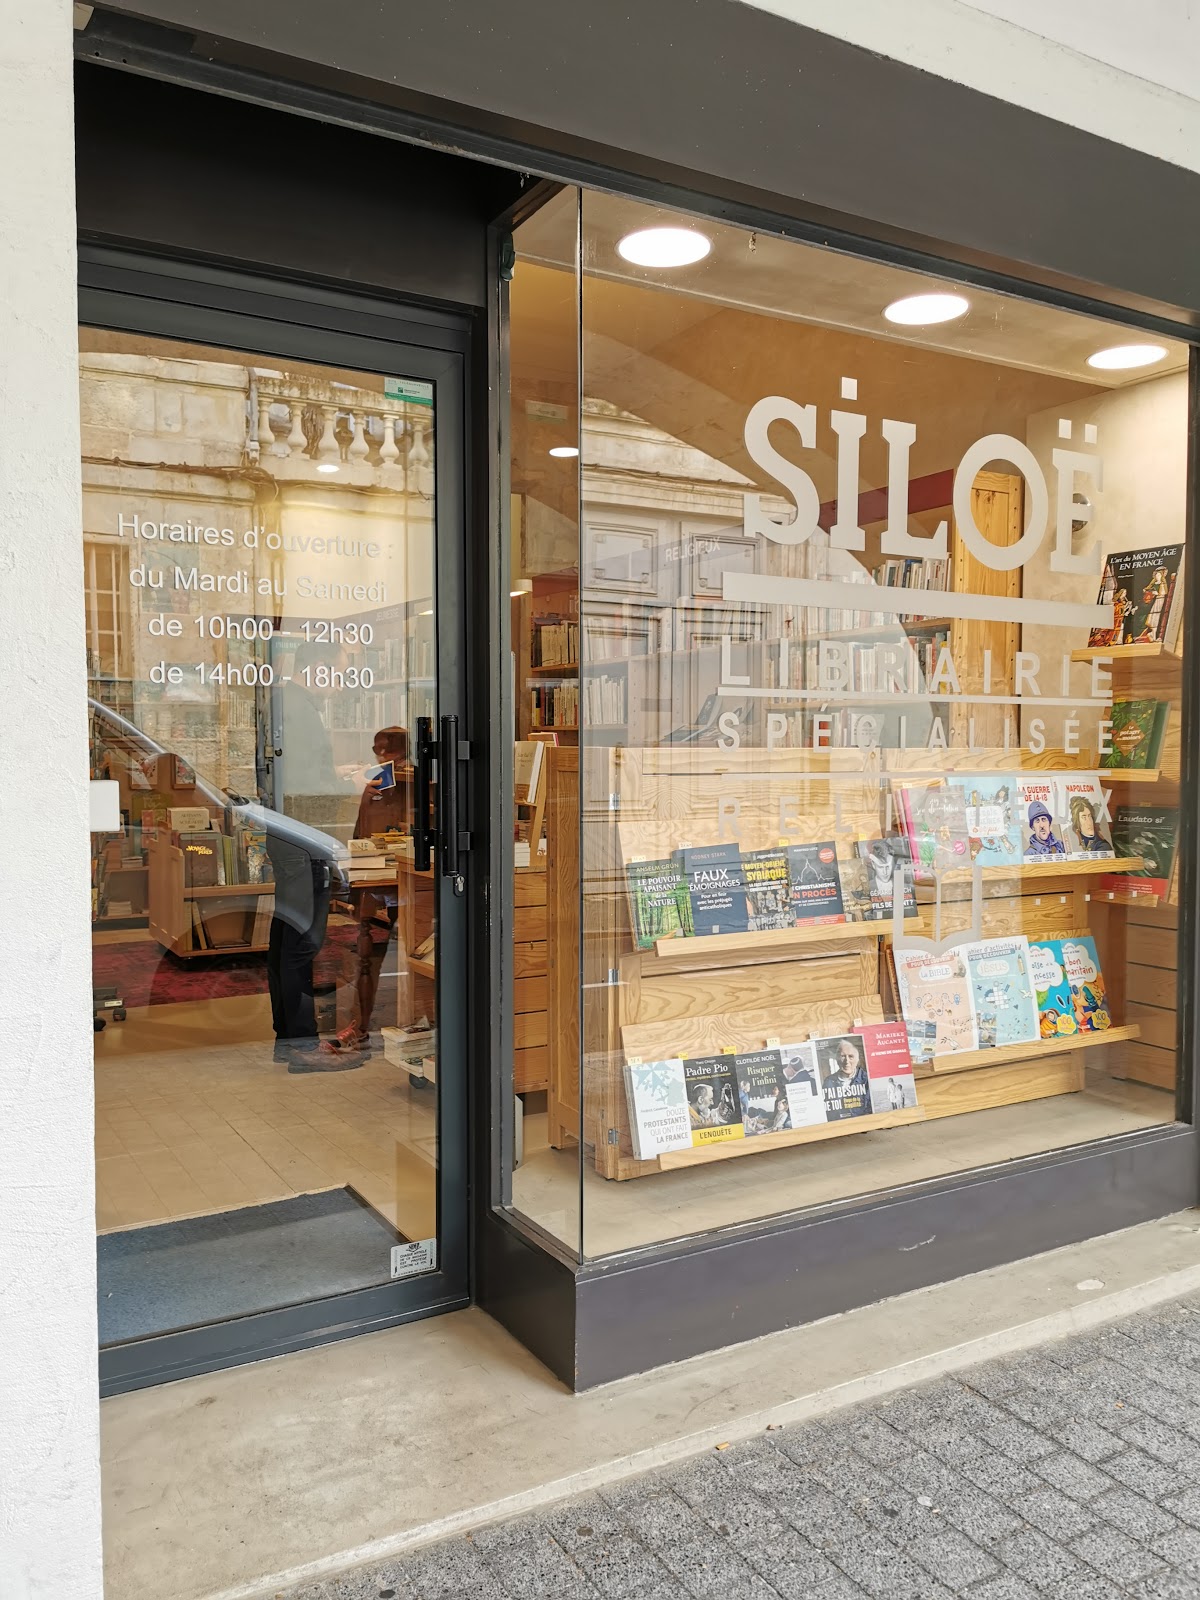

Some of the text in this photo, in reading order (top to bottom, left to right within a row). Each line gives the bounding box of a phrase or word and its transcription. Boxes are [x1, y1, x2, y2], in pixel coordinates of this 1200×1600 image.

[117, 512, 235, 547] Horaires
[243, 525, 381, 559] d'ouverture
[1131, 550, 1160, 561] MOYEN
[1160, 548, 1177, 556] ÂGE
[1119, 558, 1163, 571] EN FRANCE
[129, 564, 387, 602] du Mardi au Samedi
[148, 613, 183, 637] de
[193, 615, 274, 641] 10h00
[300, 621, 374, 645] 12h30
[721, 635, 1114, 698] LIBRAIRIE
[149, 660, 184, 684] de
[194, 662, 274, 687] 14h00
[300, 665, 374, 689] 18h30
[717, 704, 1113, 754] SPÉCIALISÉE
[1027, 784, 1051, 794] GUERRE
[1024, 794, 1033, 802] DE
[717, 789, 1113, 838] RELIIEUX
[1118, 815, 1153, 823] Laudato
[636, 865, 660, 873] ANSELM
[746, 868, 787, 881] SYRIAQUE
[637, 875, 681, 886] LE POUVOIR
[694, 868, 729, 883] FAUX
[643, 882, 677, 893] APAISANT
[795, 881, 836, 890] CHRISTIANISME
[801, 887, 837, 898] PROCÈS
[648, 898, 677, 907] NATURE
[928, 967, 950, 978] BIBLE
[875, 1032, 905, 1040] MARIEKE
[877, 1038, 906, 1046] AUCANTE
[736, 1054, 776, 1065] CLOTILDE NOËL
[686, 1063, 728, 1077] Padre Pio
[747, 1065, 775, 1077] Risquer
[752, 1074, 777, 1086] l'infini
[836, 1083, 867, 1098] BESOIN
[831, 1098, 843, 1110] TOI
[666, 1107, 686, 1117] DOUZE
[643, 1116, 687, 1129] PROTESTANTS
[650, 1123, 688, 1137] QUI ONT FAIT
[699, 1127, 732, 1140] L'ENQUÊTE
[656, 1132, 688, 1143] LA FRANCE
